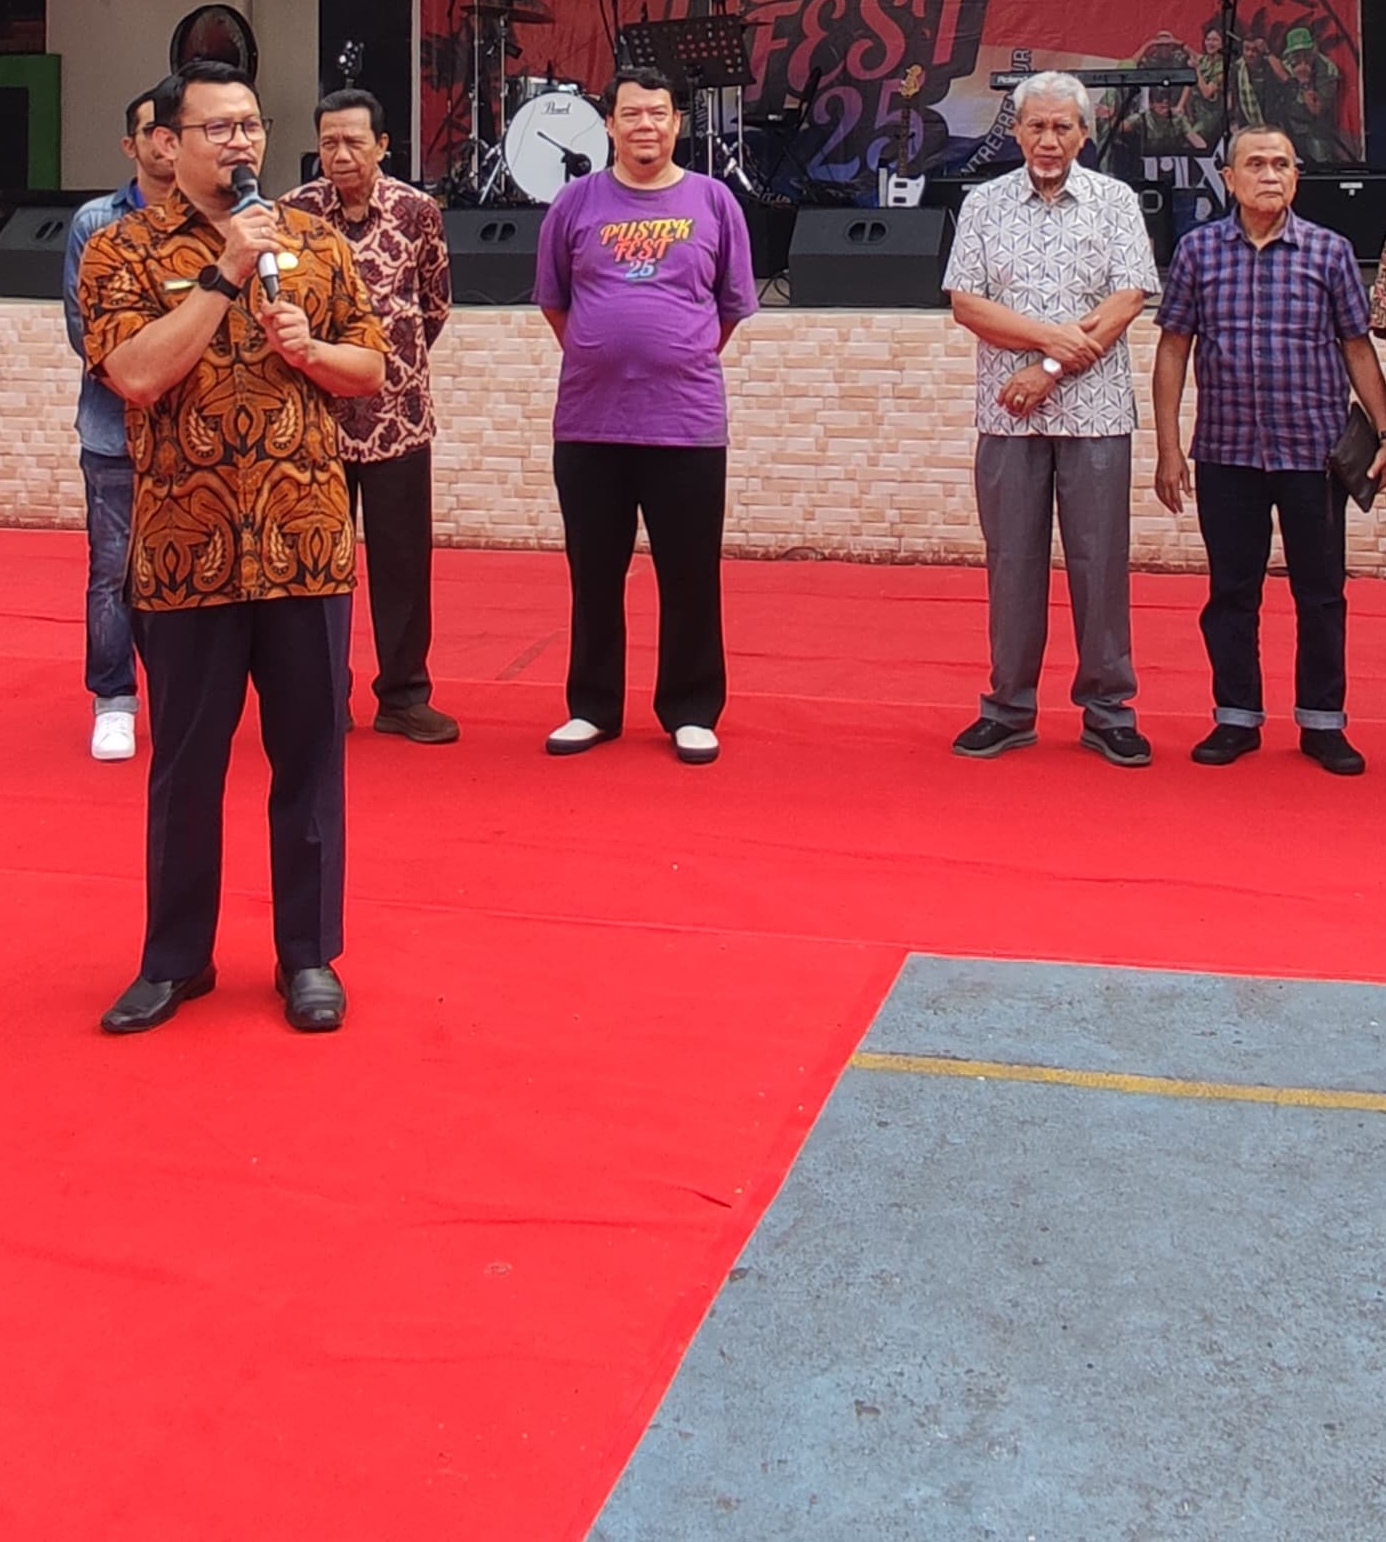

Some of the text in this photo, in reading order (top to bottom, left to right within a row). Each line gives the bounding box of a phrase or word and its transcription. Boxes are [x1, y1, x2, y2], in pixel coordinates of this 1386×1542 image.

[808, 78, 926, 182] 25
[599, 218, 693, 246] PUSTEK
[613, 238, 674, 263] FEST
[624, 257, 656, 278] 25
